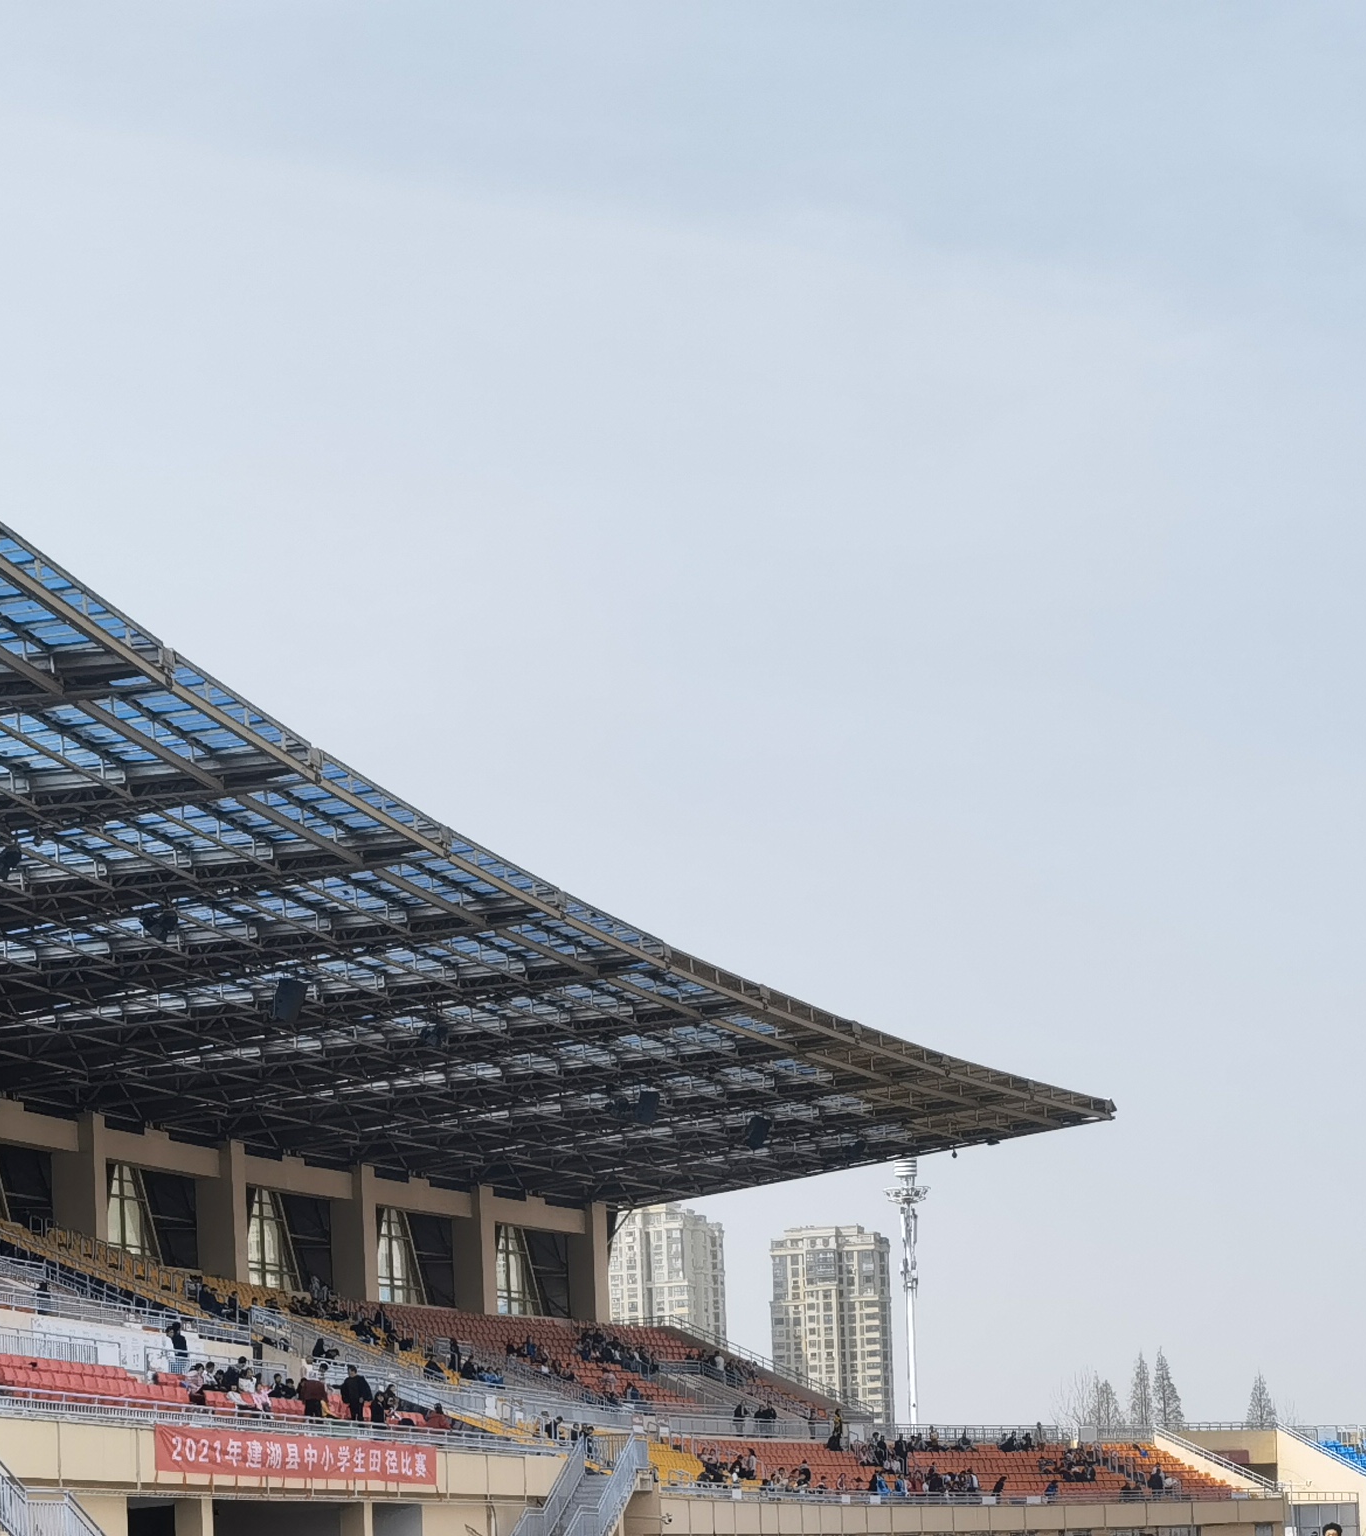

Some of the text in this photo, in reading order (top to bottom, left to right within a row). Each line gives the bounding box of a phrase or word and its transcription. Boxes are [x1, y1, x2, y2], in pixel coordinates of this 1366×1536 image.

[171, 1437, 428, 1478] 2021年建湖县中小学生田径比赛
